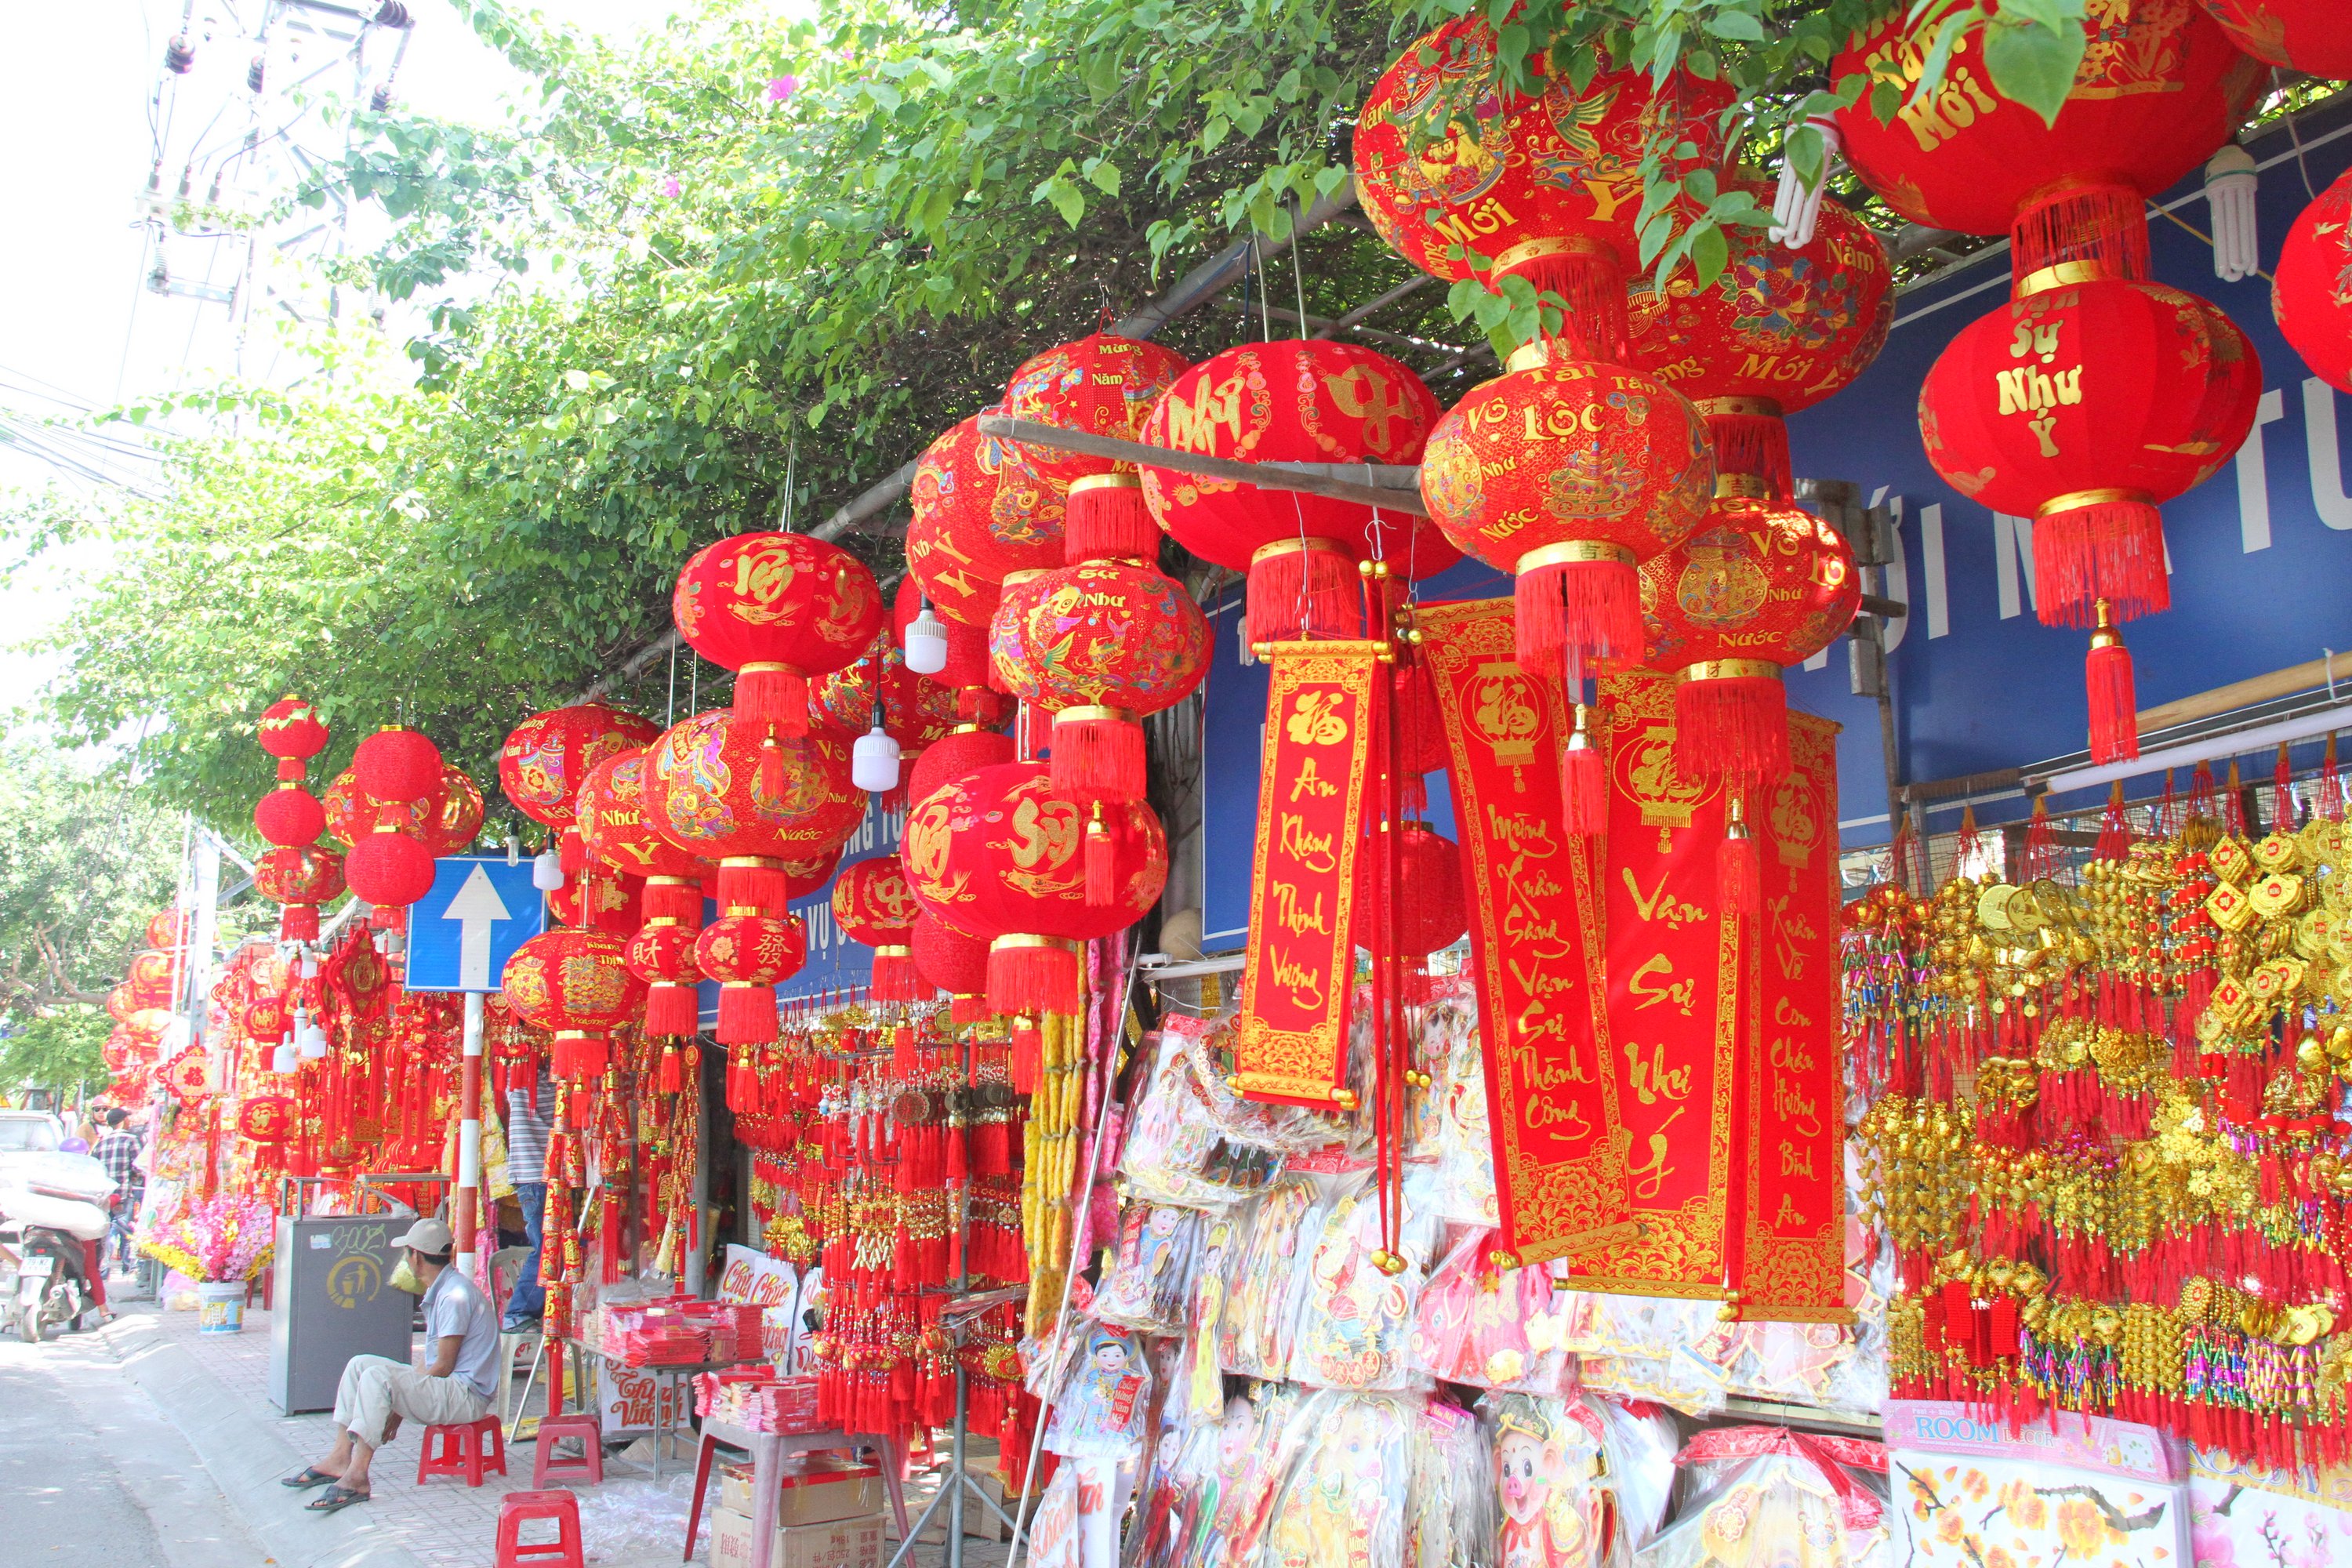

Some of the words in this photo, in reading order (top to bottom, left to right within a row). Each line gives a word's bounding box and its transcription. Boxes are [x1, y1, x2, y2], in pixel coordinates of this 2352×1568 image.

[1432, 198, 1519, 245] Mới
[2012, 290, 2079, 319] Vạn
[2010, 318, 2063, 364] Sự
[1092, 372, 1123, 386] Năm
[1733, 353, 1815, 382] Mới
[1996, 365, 2082, 416] Như
[2028, 407, 2060, 458] Ý
[1481, 456, 1518, 481] Như
[1479, 507, 1539, 543] Nước
[1083, 591, 1126, 608] Như
[1769, 589, 1802, 603] Như
[1717, 629, 1783, 648] Nước
[1287, 690, 1348, 746] 福
[1477, 683, 1537, 736] 福
[828, 792, 848, 804] Như
[1290, 757, 1338, 802] An
[601, 809, 641, 826] Như
[772, 827, 824, 841] Nước
[1486, 804, 1558, 858] Mừng
[1772, 789, 1813, 841] 福
[617, 836, 662, 865] Ý
[1279, 811, 1335, 873] Khang
[1272, 880, 1331, 938] Thịnh
[1497, 855, 1563, 920] Xuân
[1622, 867, 1709, 931] Vạn
[808, 901, 830, 960] VỤ
[1504, 903, 1571, 959] Sang
[1767, 895, 1817, 953] Xuân
[633, 938, 662, 968] 財
[752, 933, 793, 967] 發
[1270, 943, 1323, 1011] Vượng
[1508, 956, 1573, 999] Vạn
[1628, 953, 1696, 1017] Sự
[1518, 1000, 1567, 1045] Sự
[1775, 996, 1813, 1027] Con
[1511, 1044, 1596, 1091] Thành
[1624, 1041, 1693, 1105] Như
[1770, 1036, 1816, 1073] Cháu
[1526, 1093, 1592, 1141] Công
[1773, 1069, 1821, 1138] Hưởng
[1623, 1105, 1686, 1200] Ý
[1778, 1138, 1820, 1182] Bình
[1775, 1192, 1807, 1229] An
[1914, 1416, 2000, 1443] ROOM
